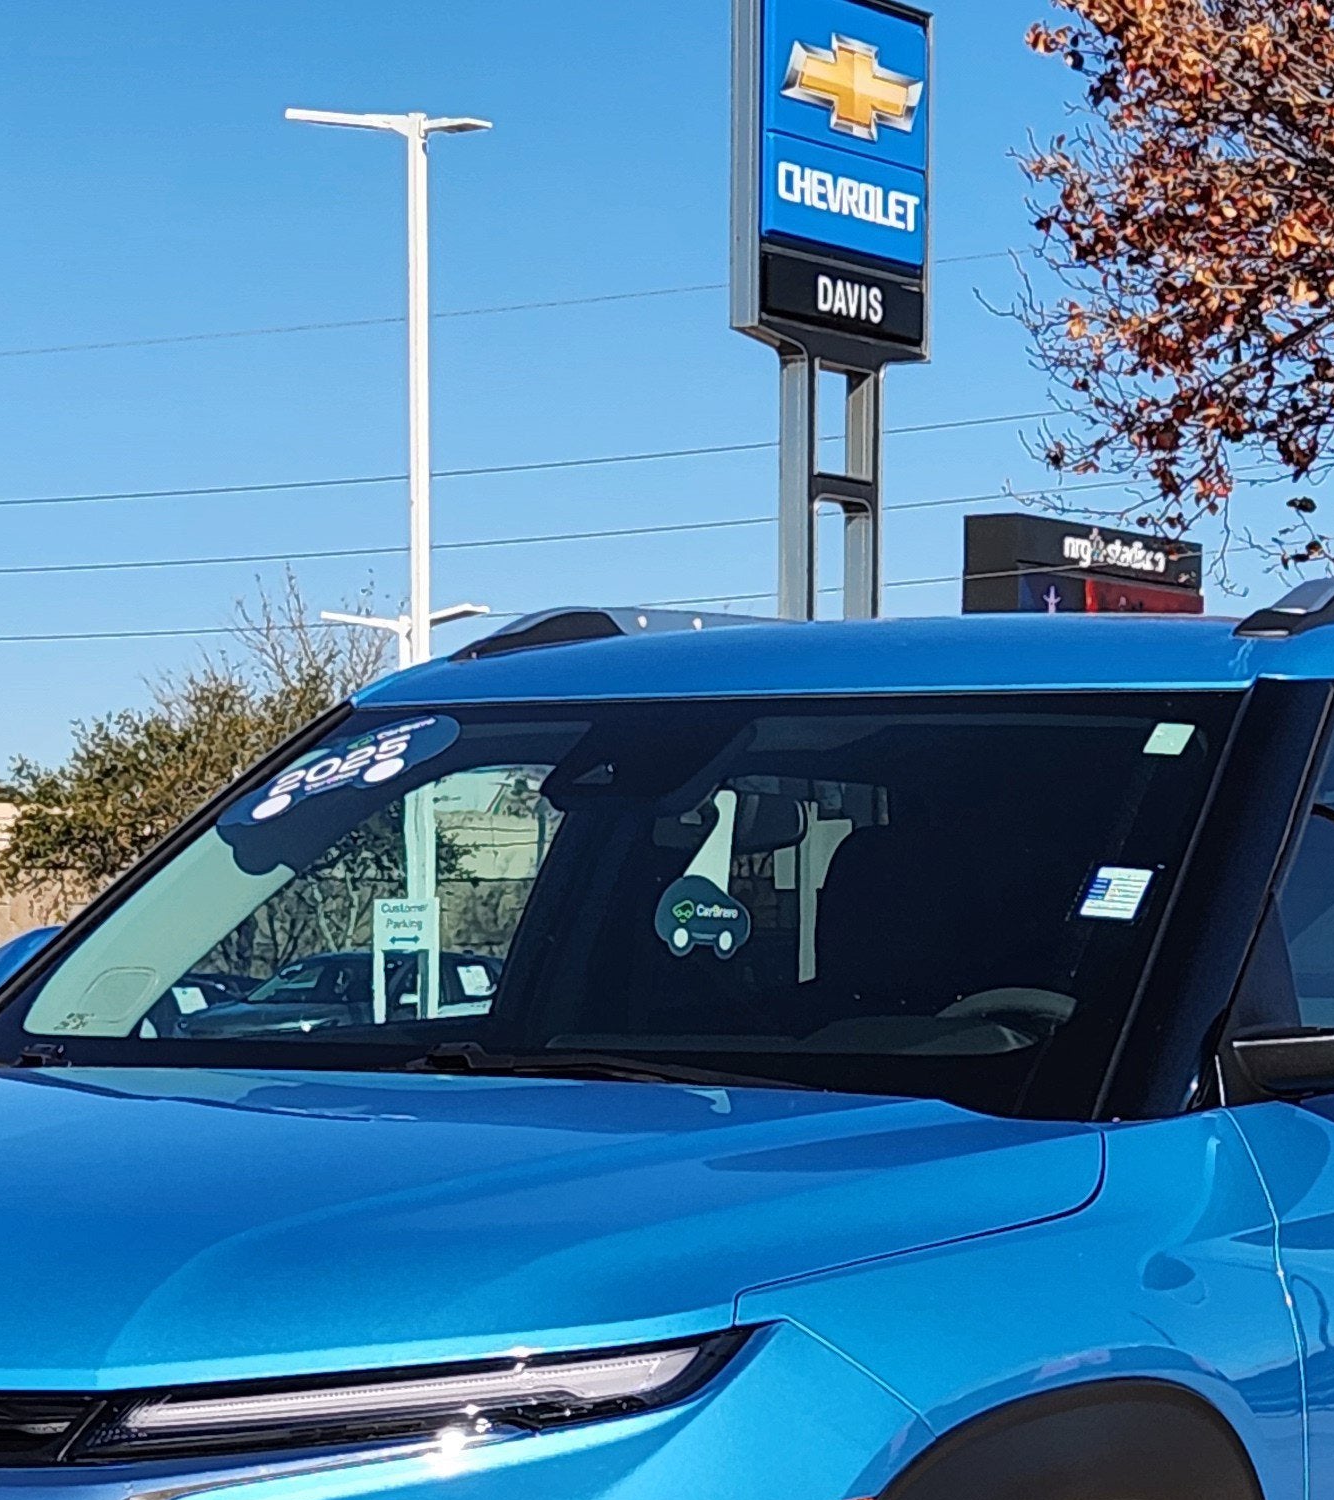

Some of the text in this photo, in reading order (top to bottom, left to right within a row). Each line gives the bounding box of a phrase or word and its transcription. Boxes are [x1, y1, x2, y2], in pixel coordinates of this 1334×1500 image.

[777, 161, 920, 232] CHEVROLET
[817, 274, 883, 324] DAVIS
[1063, 536, 1092, 568] nrg
[268, 734, 411, 797] 2025
